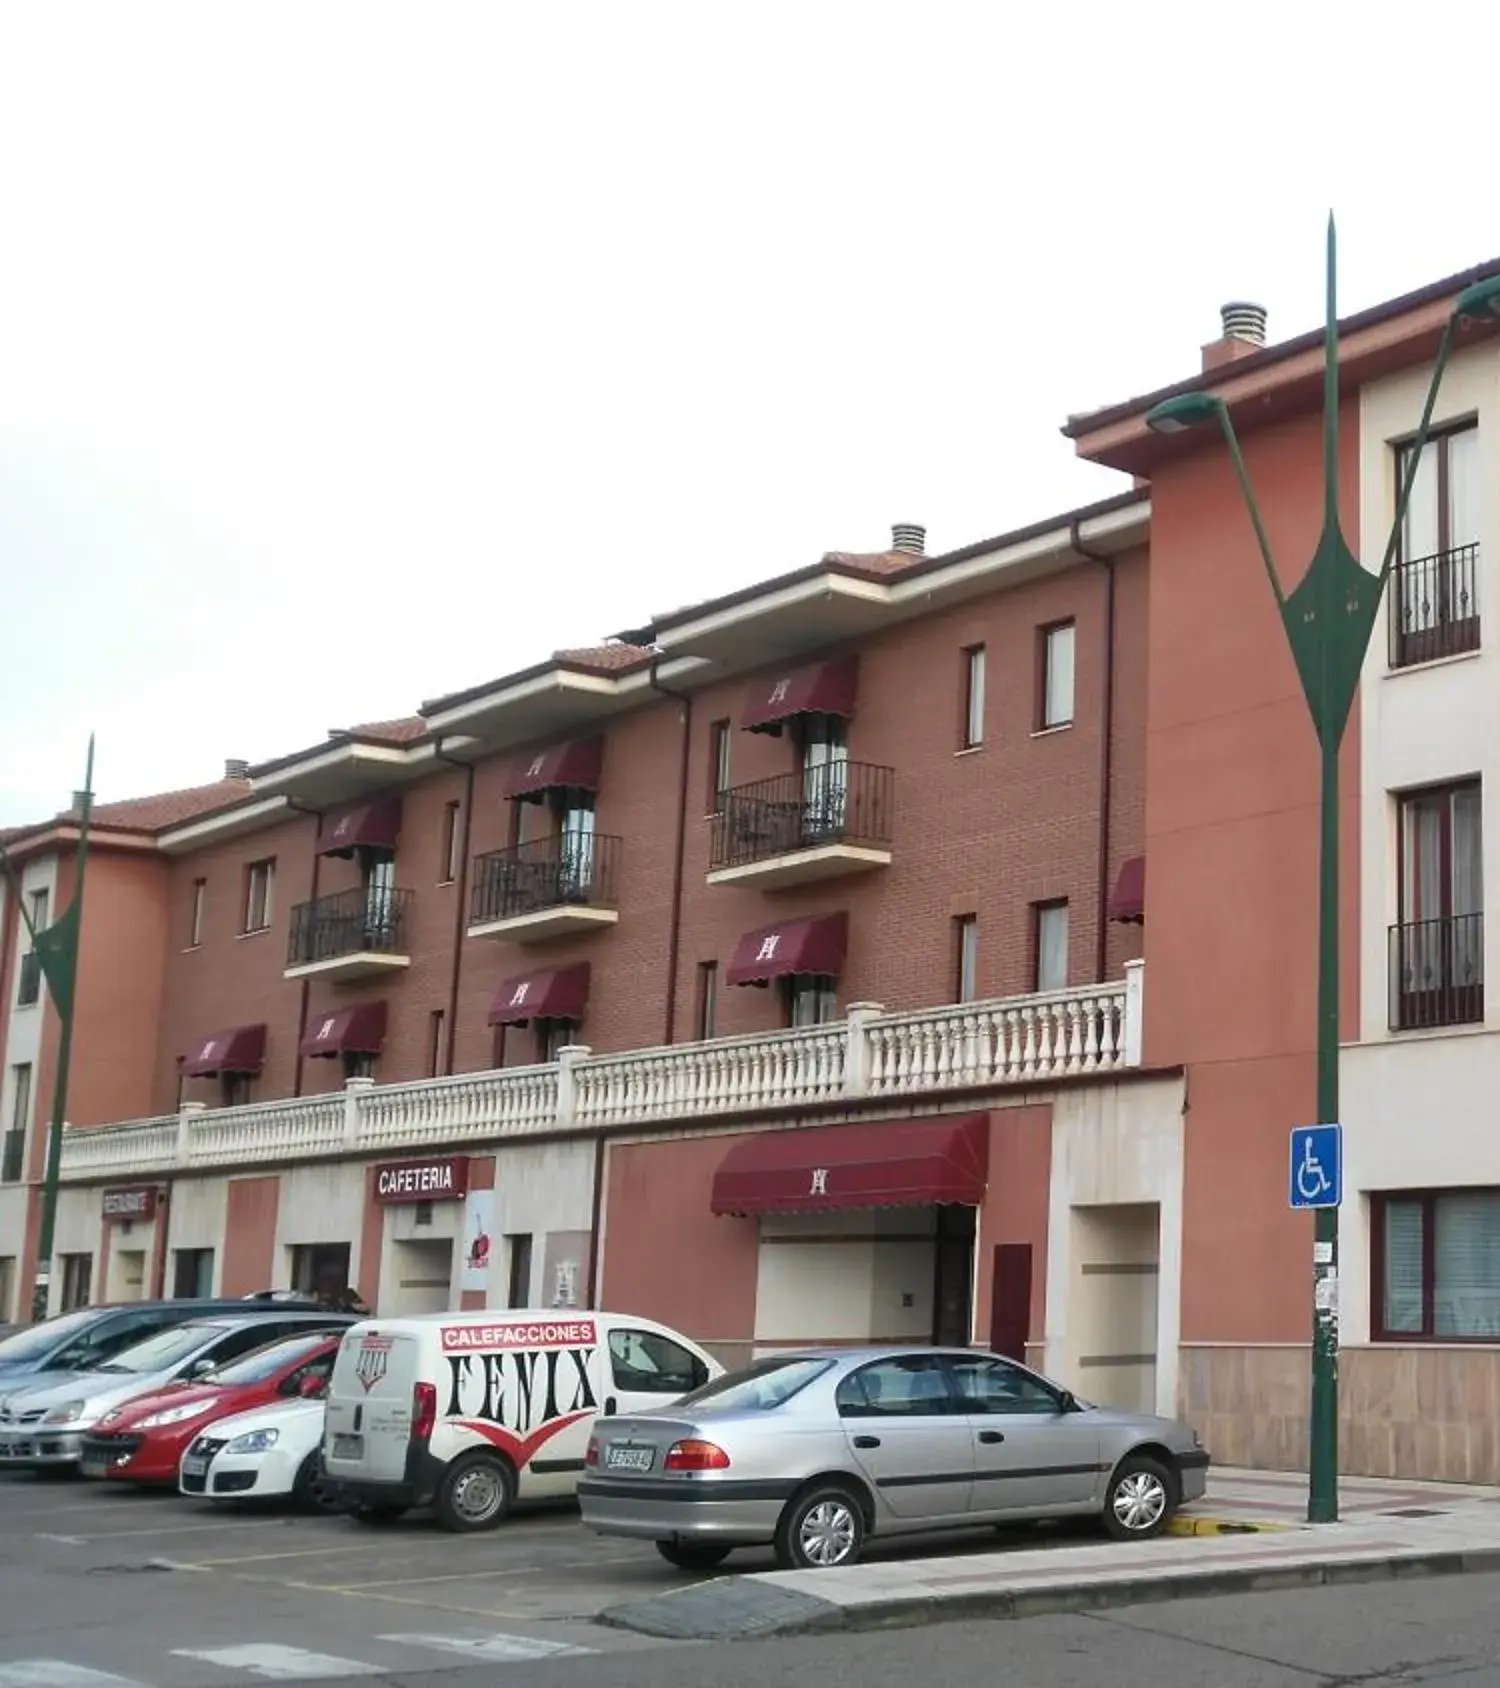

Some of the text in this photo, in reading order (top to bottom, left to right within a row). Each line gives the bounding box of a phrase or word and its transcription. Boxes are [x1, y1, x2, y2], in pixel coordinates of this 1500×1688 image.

[379, 1165, 453, 1195] CAFETERIA
[444, 1324, 592, 1347] CALEFACCIONES
[444, 1348, 598, 1432] FENIX
